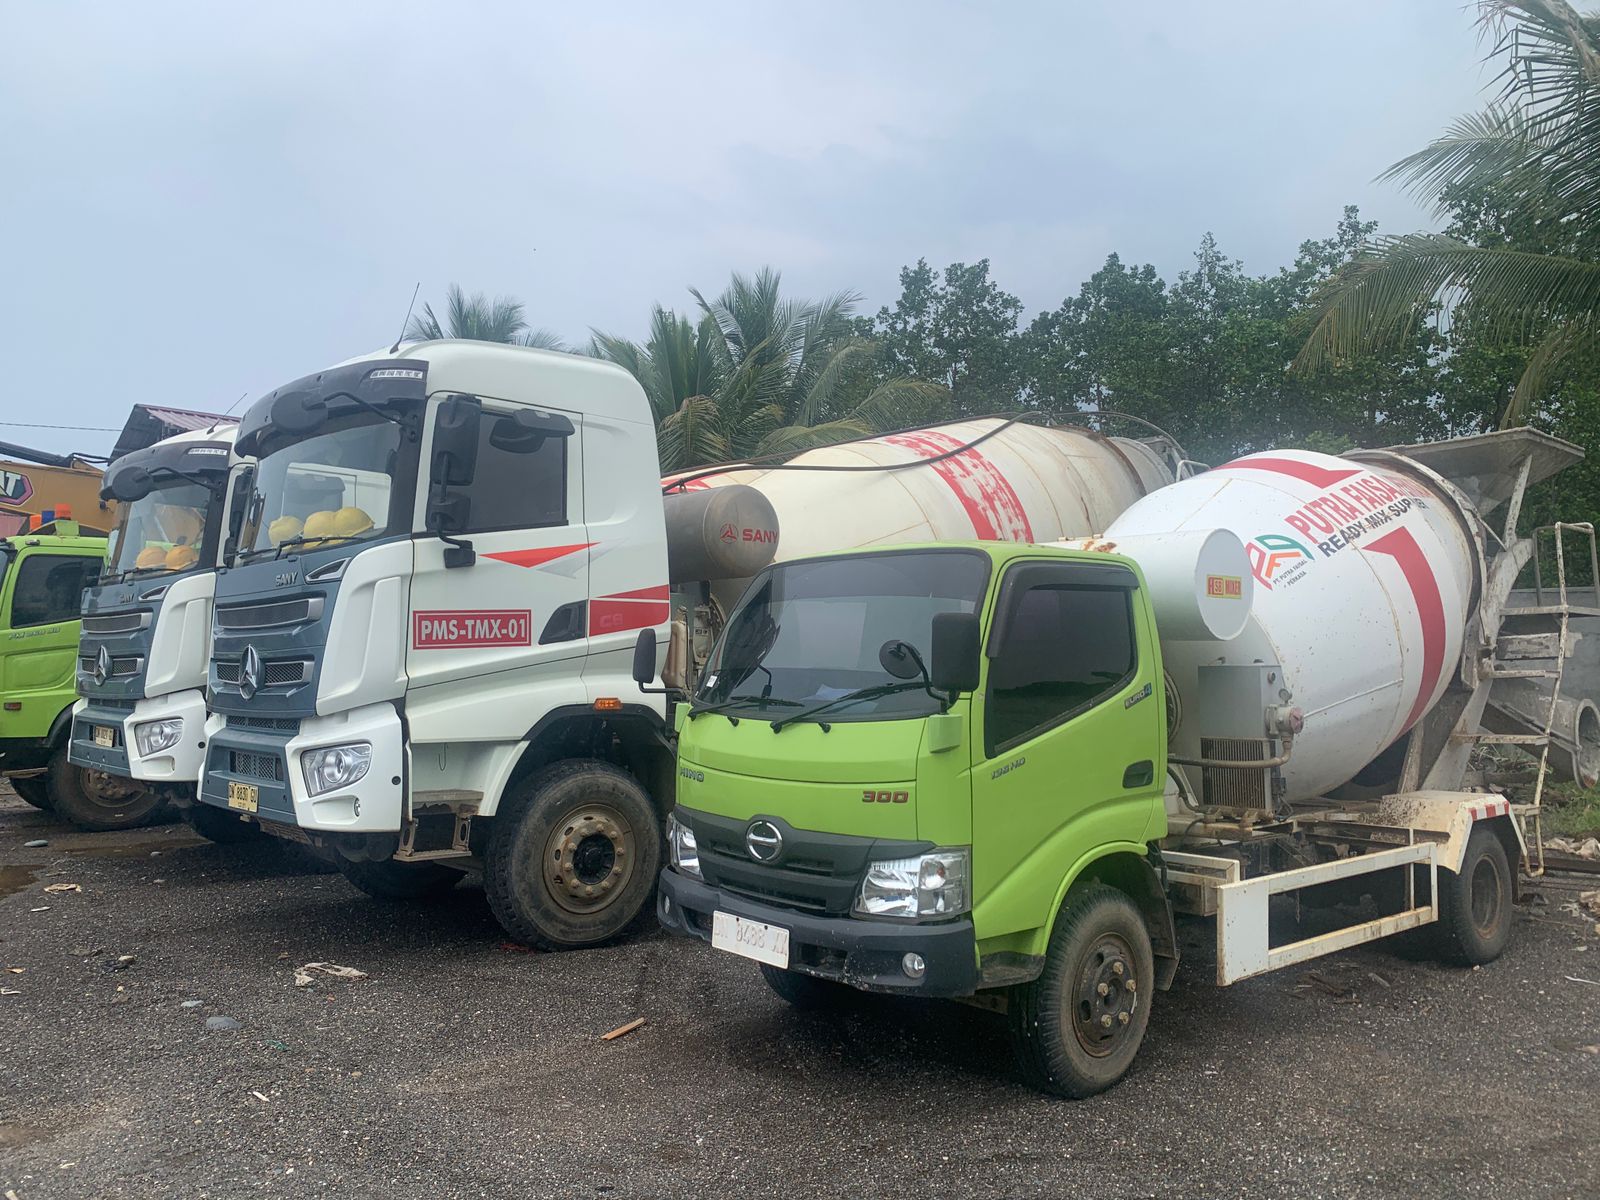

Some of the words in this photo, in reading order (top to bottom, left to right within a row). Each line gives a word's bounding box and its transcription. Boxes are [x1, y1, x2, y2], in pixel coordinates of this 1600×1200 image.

[1284, 491, 1360, 545] PUTRA
[1343, 475, 1404, 514] FAISA
[742, 528, 778, 544] SANY
[1317, 521, 1367, 559] READY
[1364, 509, 1393, 530] MIX
[275, 571, 299, 587] SANY
[421, 618, 526, 640] PMS-TMX-01
[680, 766, 705, 783] HINO
[862, 790, 909, 804] 300
